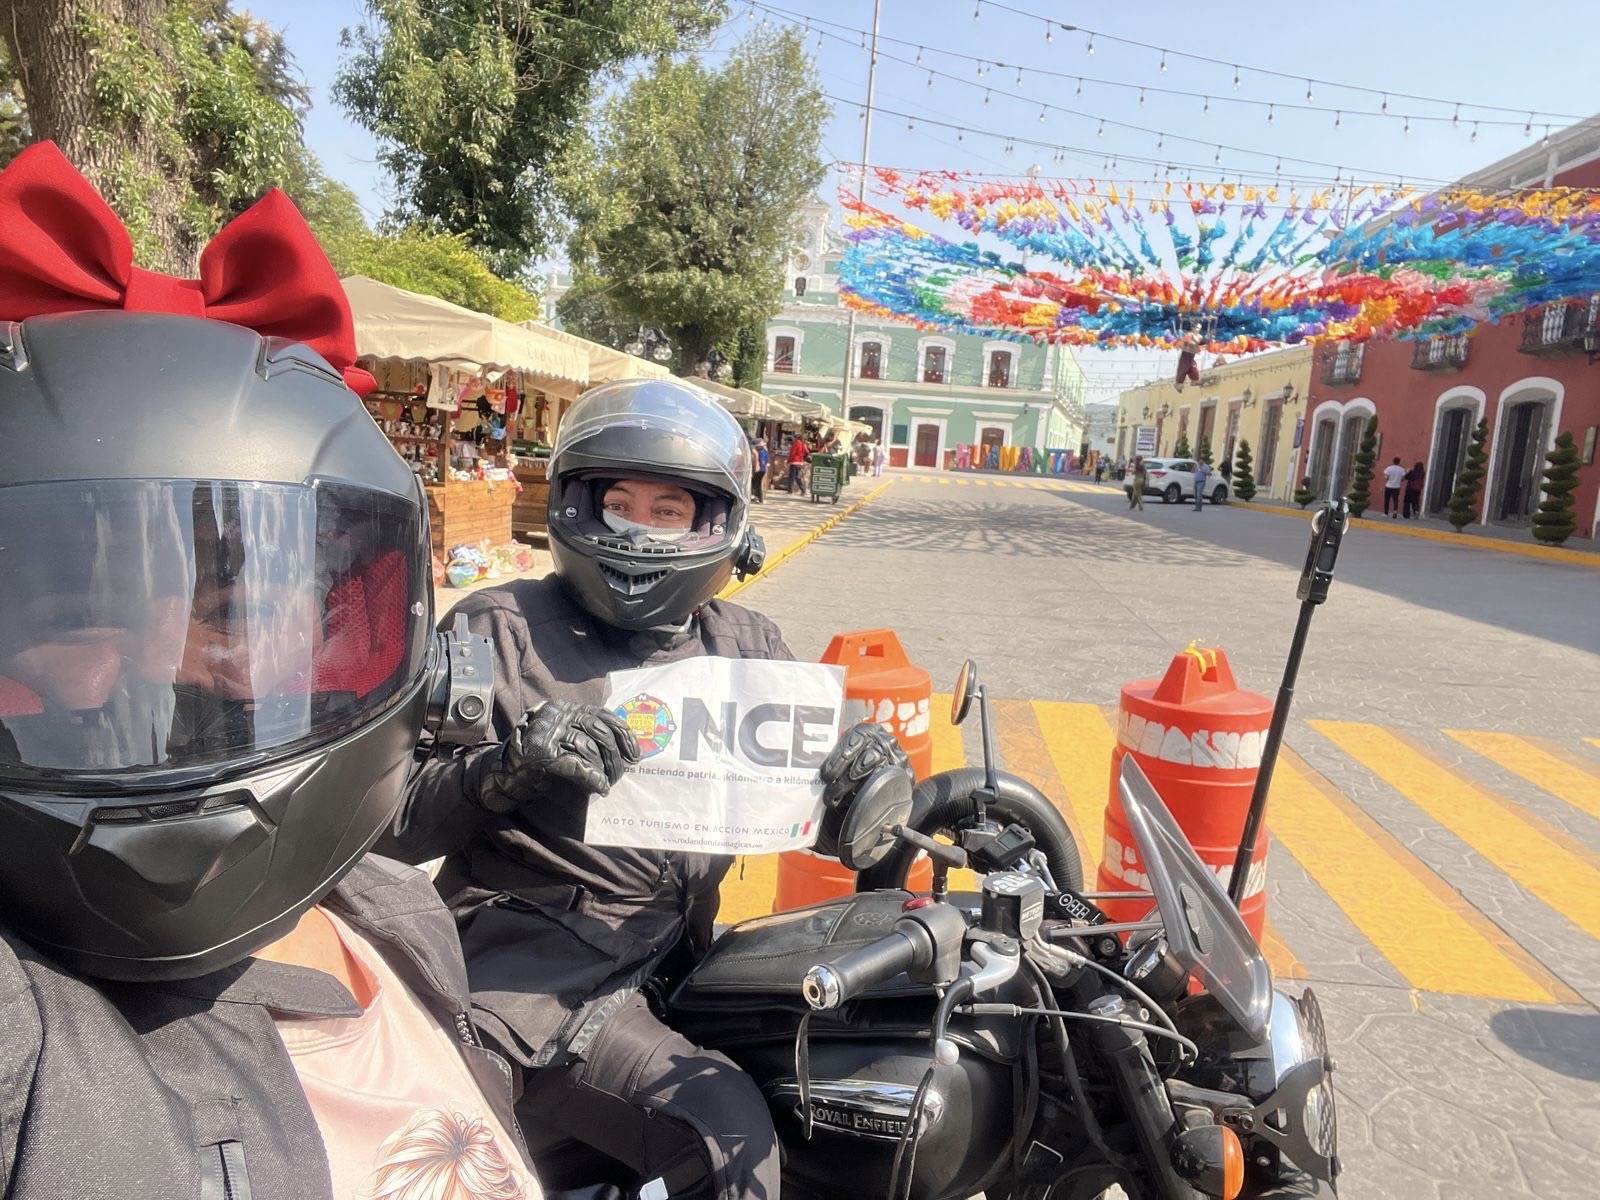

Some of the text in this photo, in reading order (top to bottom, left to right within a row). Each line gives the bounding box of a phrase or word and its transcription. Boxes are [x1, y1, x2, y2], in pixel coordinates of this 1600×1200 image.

[638, 766, 685, 777] haciendo
[601, 817, 634, 826] MOTO
[640, 819, 690, 830] TURISMO
[694, 824, 709, 832] EN
[809, 1103, 851, 1125] ROYAL
